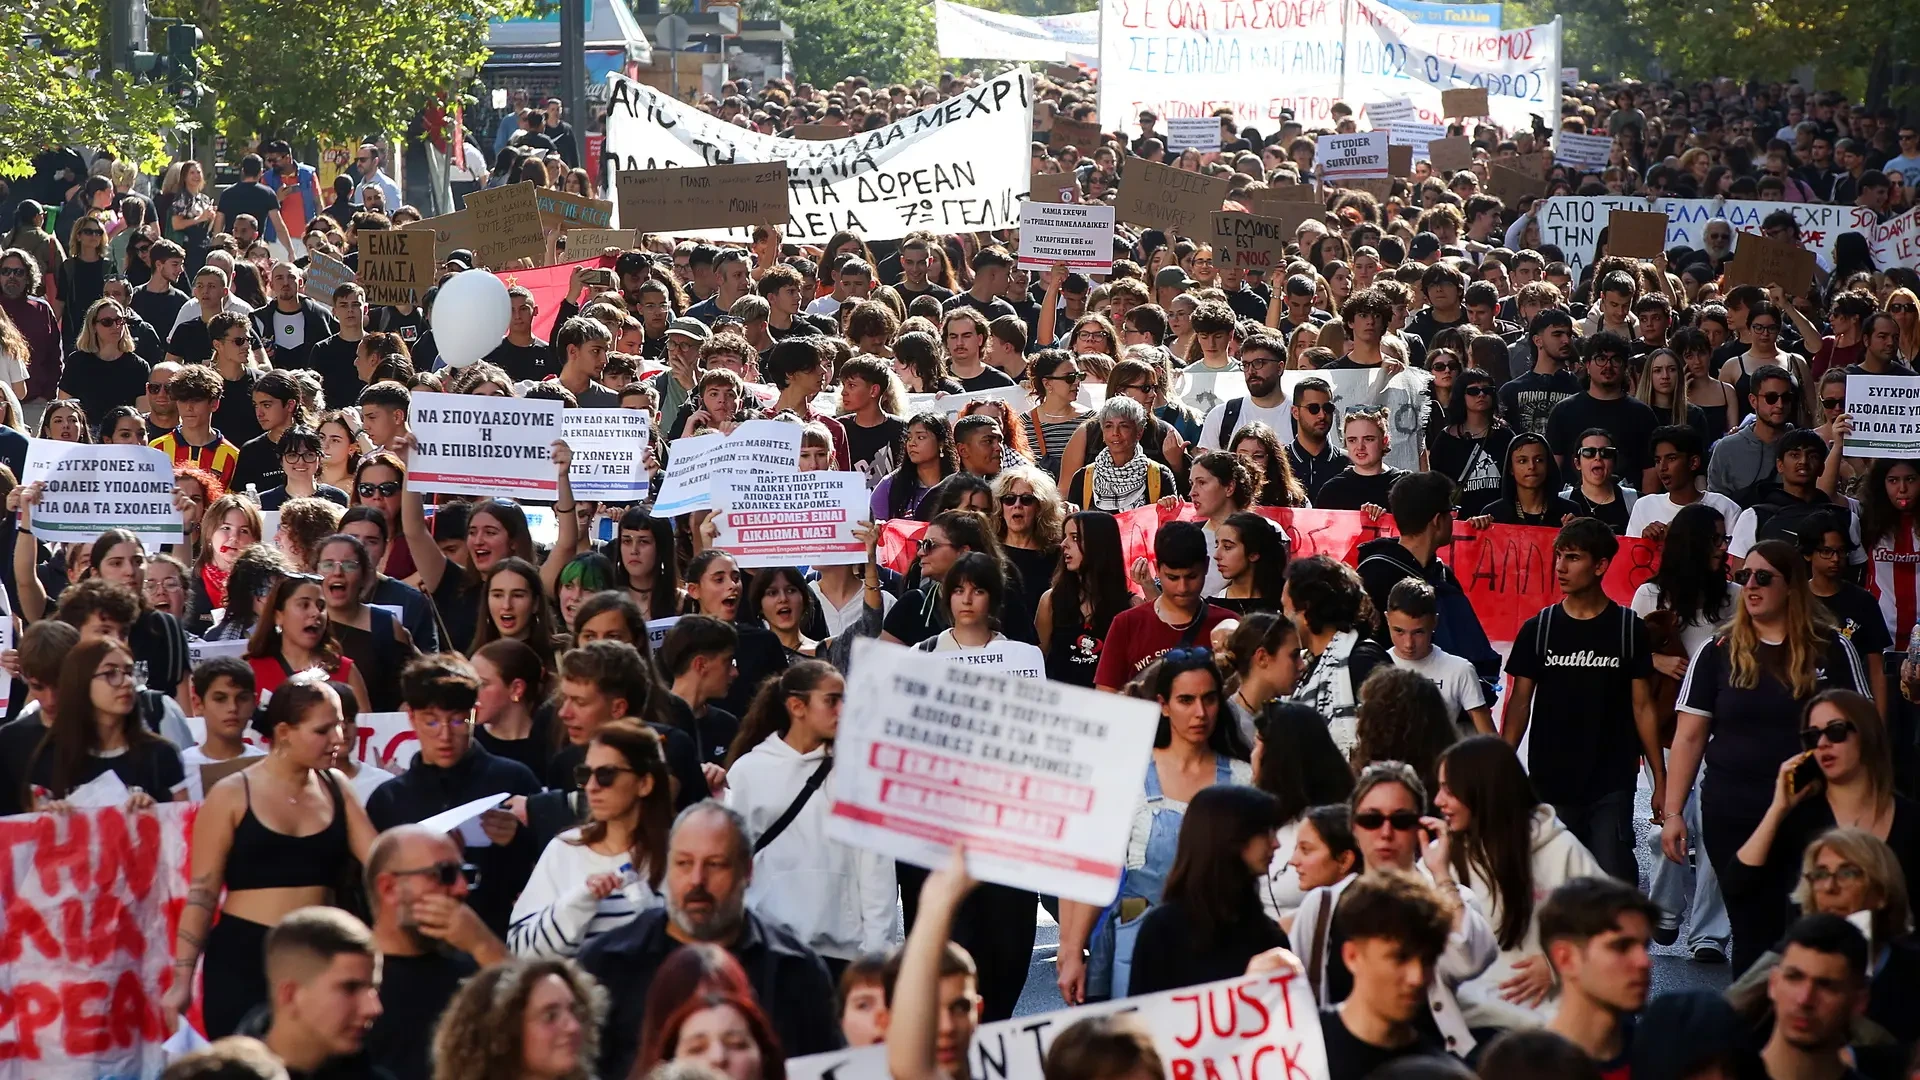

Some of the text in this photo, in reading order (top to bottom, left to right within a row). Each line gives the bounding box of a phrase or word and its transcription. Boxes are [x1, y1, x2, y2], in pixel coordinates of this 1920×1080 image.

[914, 74, 1028, 133] ΜΕΧΡΙ
[1330, 137, 1370, 149] ÉTUDIER
[1344, 147, 1357, 157] OU
[1326, 154, 1379, 168] SURVIVRE?
[789, 161, 975, 205] ΓΙΑ ΔΩΡΕΑΝ
[558, 198, 581, 219] THE
[1042, 207, 1087, 217] ΚΑΜΙΑ ΣΚΕΨΗ
[1548, 201, 1595, 224] ΑΠΟ
[1055, 219, 1109, 229] ΠΑΝΕΛΛΑΔΙΚΕΣ!
[1216, 218, 1280, 240] LE MONDE
[1035, 235, 1070, 244] ΚΑΤΑΡΓΗΣΗ
[1236, 235, 1255, 248] EST
[1548, 226, 1594, 246] ΤΗΝ
[1033, 246, 1096, 257] ΤΡΑΠΕΖΑΣ ΘΕΜΑΤΩΝ
[1236, 250, 1271, 266] NOUS
[363, 261, 416, 282] ΓΑΛΛΙΑ
[1848, 403, 1906, 416] ΑΣΦΑΛΕΙΣ
[418, 409, 554, 426] ΝΑ ΣΠΟΥΔΑΣΟΥΜΕ
[584, 416, 646, 425] ΕΔΩ ΚΑΙ ΤΩΡΑ
[571, 429, 647, 439] ΕΚΠΑΙΔΕΥΤΙΚΩΝ!
[1852, 422, 1913, 434] ΓΙΑ ΟΛΑ ΤΑ
[418, 443, 551, 460] ΝΑ ΕΠΙΒΙΩΣΟΥΜΕ;
[745, 439, 793, 451] ΜΑΘΗΤΕΣ,
[56, 459, 135, 471] ΣΥΓΧΡΟΝΕΣ
[138, 463, 155, 472] ΚΑΙ
[709, 453, 736, 465] ΤΙΜΩΝ
[752, 453, 795, 466] ΚΥΛΙΚΕΙΑ
[602, 465, 630, 475] ΤΑΞΗ
[757, 473, 816, 484] ΠΑΡΤΕ ΠΙΣΩ
[43, 481, 100, 493] ΣΦΑΛΕΙΣ
[731, 481, 844, 492] ΤΗΝ ΑΔΙΚΗ ΥΠΟΥΡΓΙΚΗ
[743, 491, 829, 501] ΑΠΟΦΑΣΗ ΓΙΑ ΤΙΣ
[38, 502, 172, 514] ΓΙΑ ΟΛΑ ΤΑ ΣΧΟΛΕΙΑ
[732, 499, 841, 510] ΣΧΟΛΙΚΕΣ ΕΚΔΡΟΜΕΣ!
[732, 509, 844, 526] ΟΙ ΕΚΔΡΟΜΕΣ ΕΙΝΑΙ
[742, 527, 832, 542] ΔΙΚΑΙΩΜΑ ΜΑΣ!
[1544, 649, 1620, 668] Southland
[1172, 973, 1297, 1049] JUST
